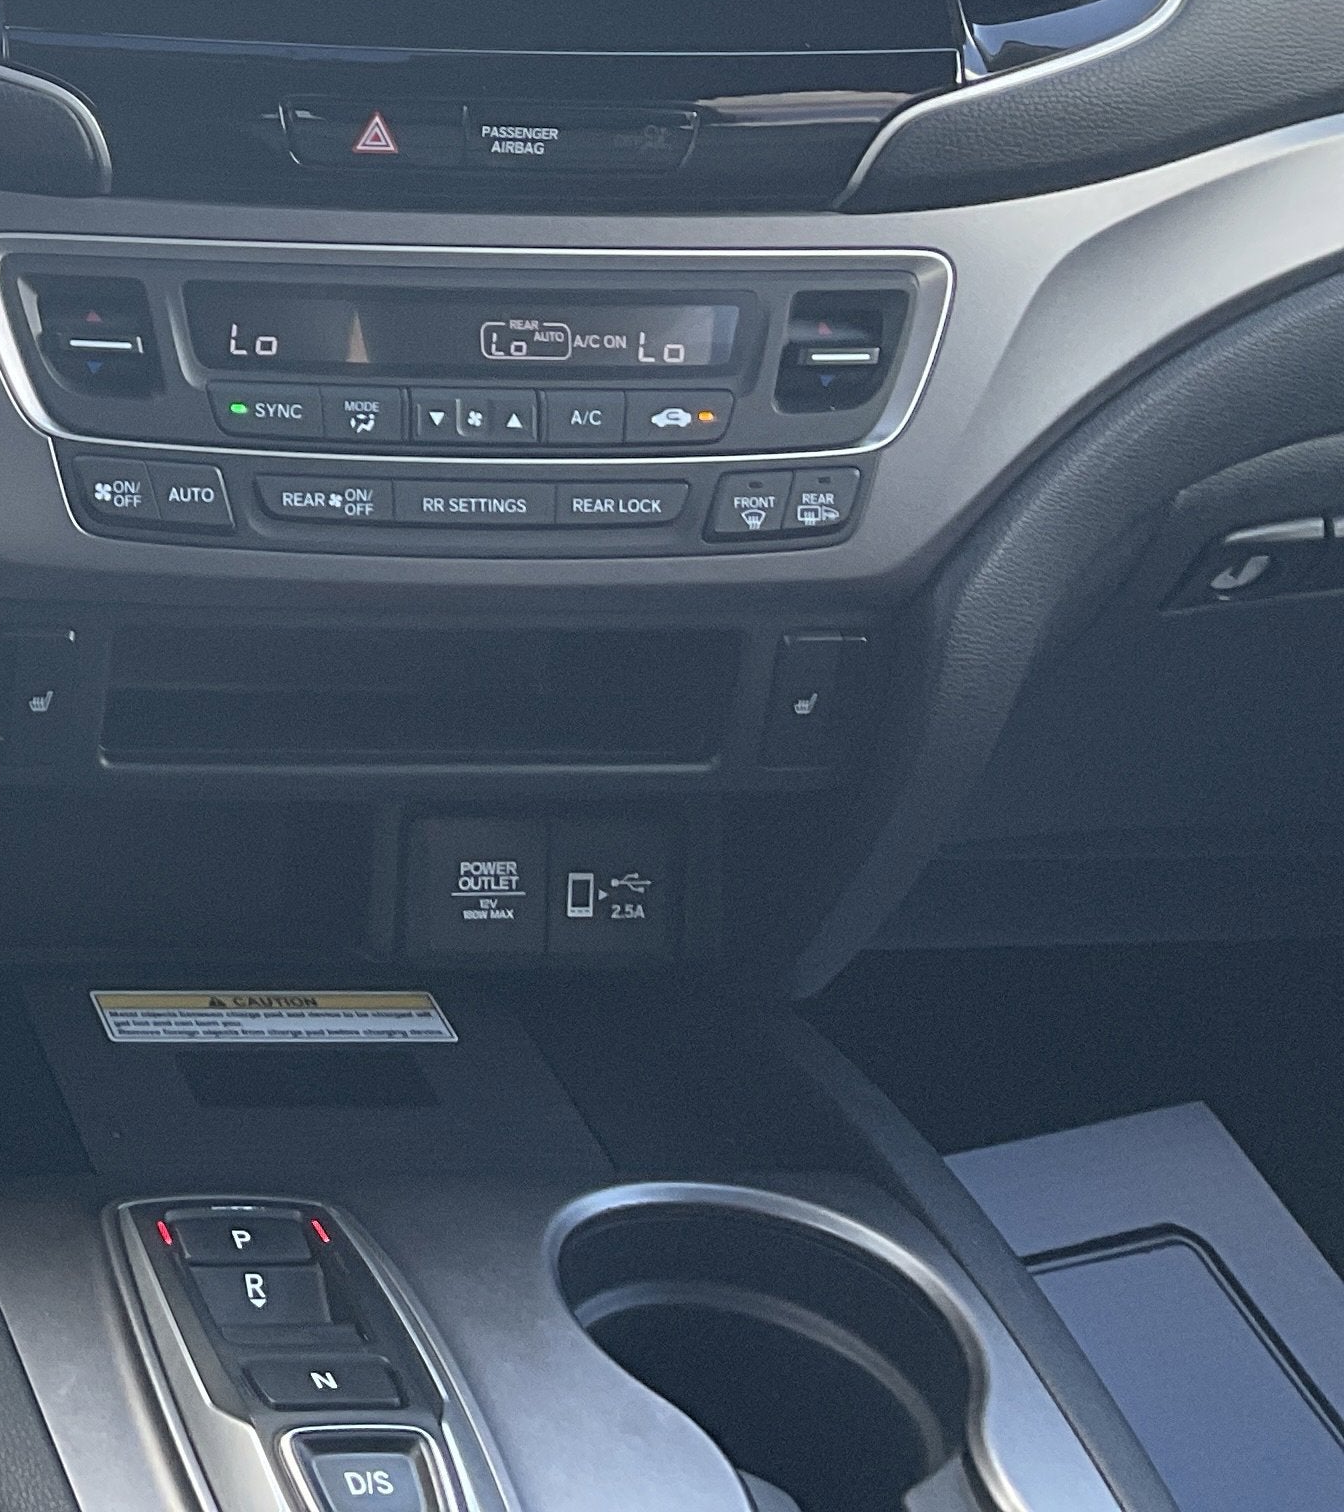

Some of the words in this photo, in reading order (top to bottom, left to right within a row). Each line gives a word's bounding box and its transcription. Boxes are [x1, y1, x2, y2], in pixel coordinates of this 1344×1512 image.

[482, 126, 558, 140] PASSENGER
[491, 141, 544, 154] AIRBAG
[510, 320, 538, 330] REAR
[230, 324, 277, 355] Lo
[534, 332, 564, 342] AUTO
[574, 335, 600, 347] A/C
[604, 336, 627, 348] ON
[492, 333, 527, 355] Lo
[639, 332, 685, 363] Lo
[256, 403, 302, 419] SYNC
[345, 401, 379, 412] MODE
[571, 410, 601, 425] A/C
[113, 481, 140, 493] ON/
[114, 495, 141, 507] OFF
[169, 488, 214, 502] AUTO
[283, 493, 325, 506] REAR
[345, 489, 372, 501] ON/
[802, 493, 834, 505] REAR
[423, 498, 444, 511] RR
[449, 498, 526, 512] SETTINGS
[573, 499, 614, 512] REAR
[619, 499, 661, 512] LOCK
[734, 496, 775, 508] FRONT
[345, 503, 373, 515] OFF
[461, 862, 517, 875] POWER
[459, 876, 519, 890] OUTLET
[480, 899, 498, 908] 12V
[491, 909, 514, 919] MAX
[611, 904, 645, 918] 2.5A
[232, 996, 318, 1008] CAUTION
[232, 1231, 251, 1249] P
[245, 1273, 266, 1298] R
[311, 1373, 337, 1388] N
[344, 1471, 393, 1495] D/S
